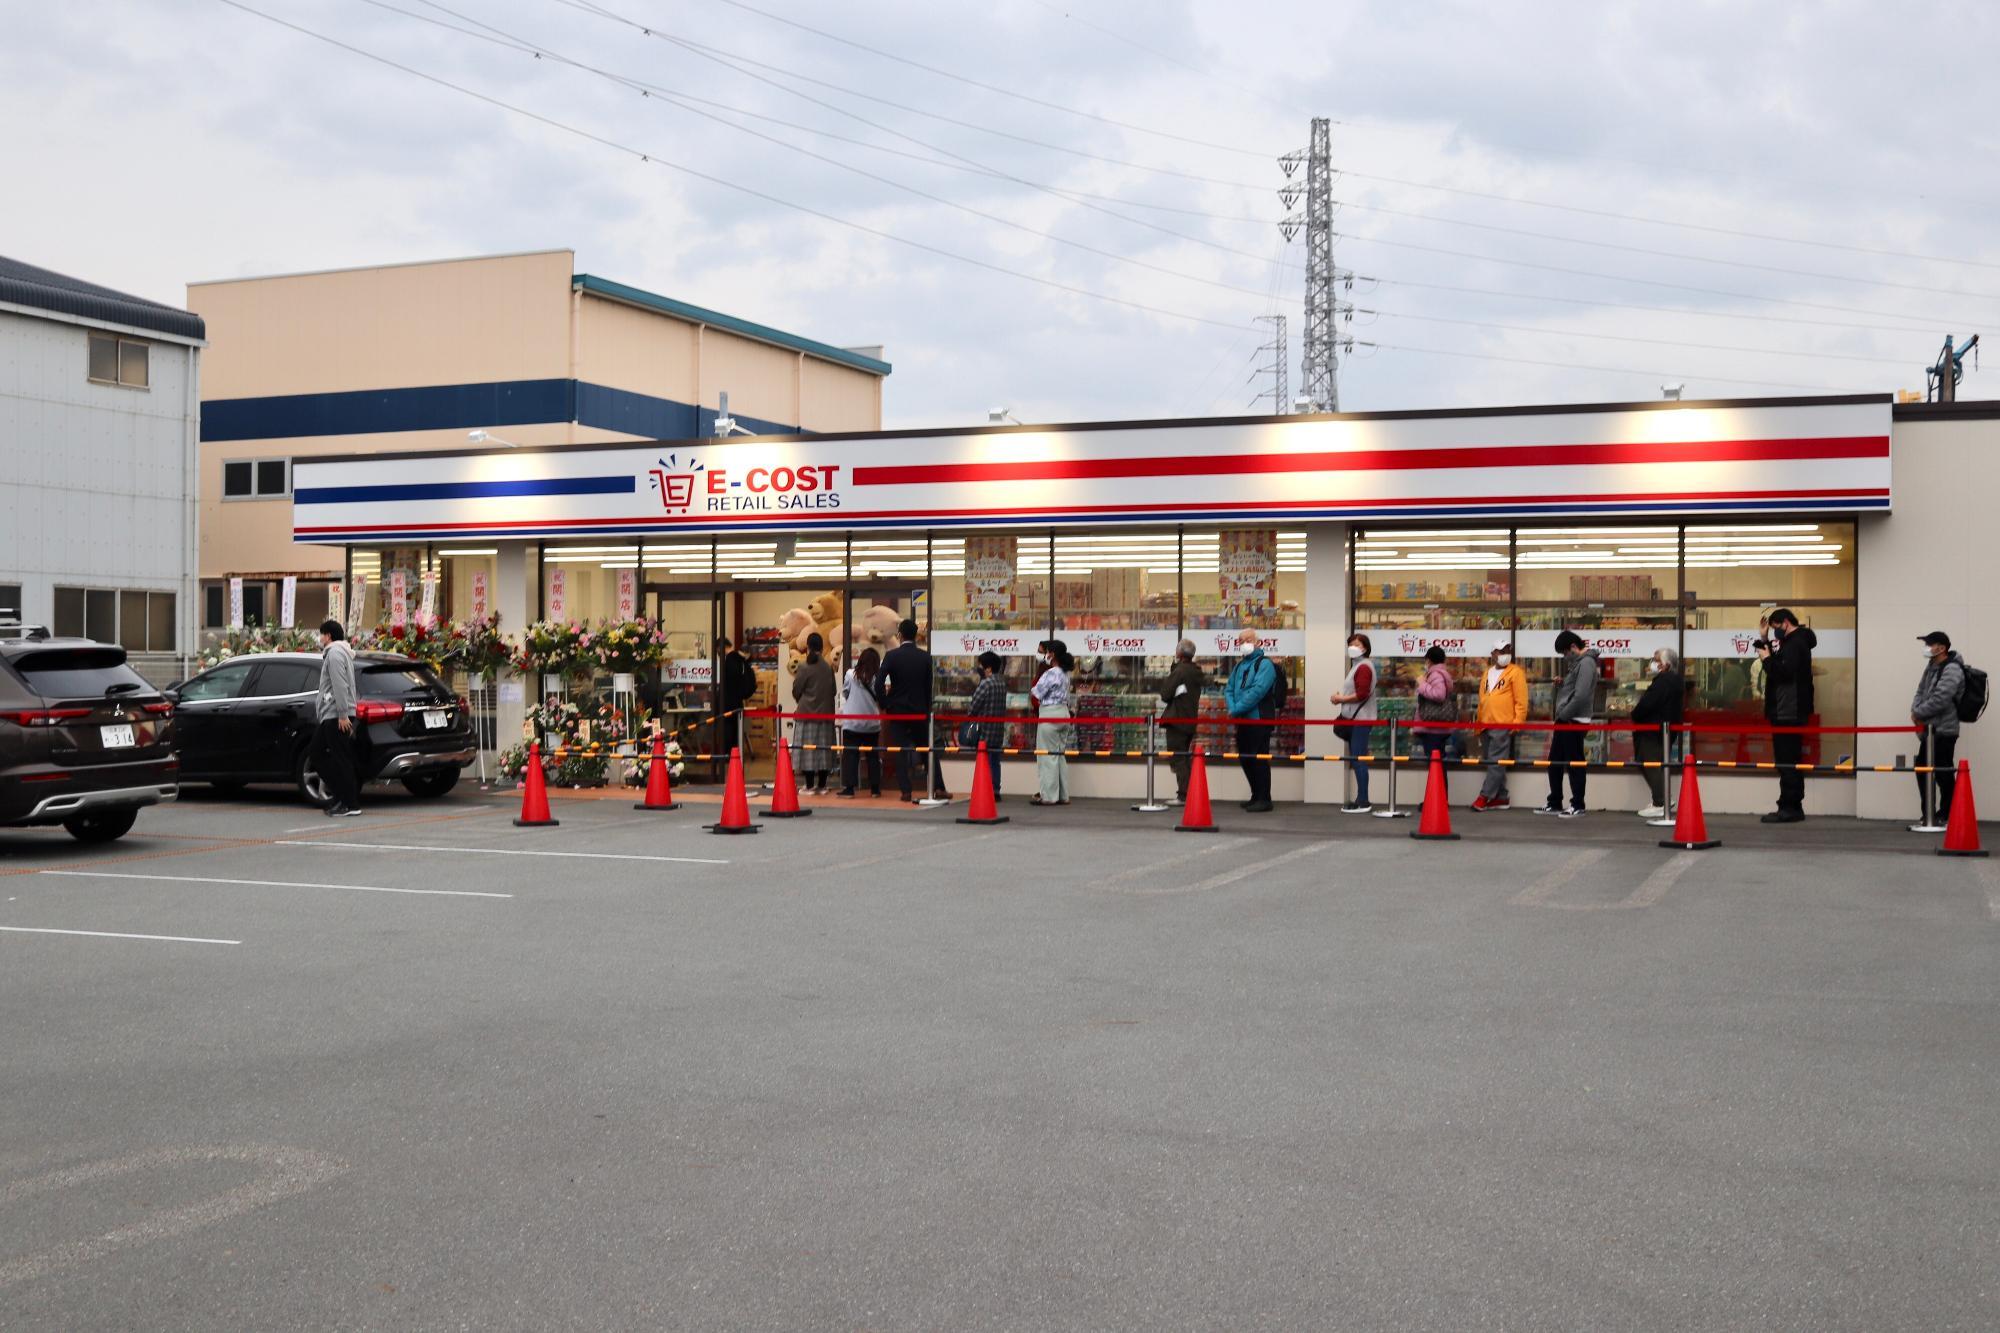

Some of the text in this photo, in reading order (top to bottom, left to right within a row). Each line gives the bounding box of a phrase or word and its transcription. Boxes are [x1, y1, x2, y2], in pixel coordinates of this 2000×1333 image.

[707, 465, 840, 494] E-COST
[707, 493, 841, 511] RETAIL SALES
[978, 639, 1019, 647] E-COST
[1103, 639, 1145, 647] E-COST
[1419, 639, 1466, 647] E-COST
[1583, 640, 1631, 648] E-COST
[681, 667, 712, 675] E-COS
